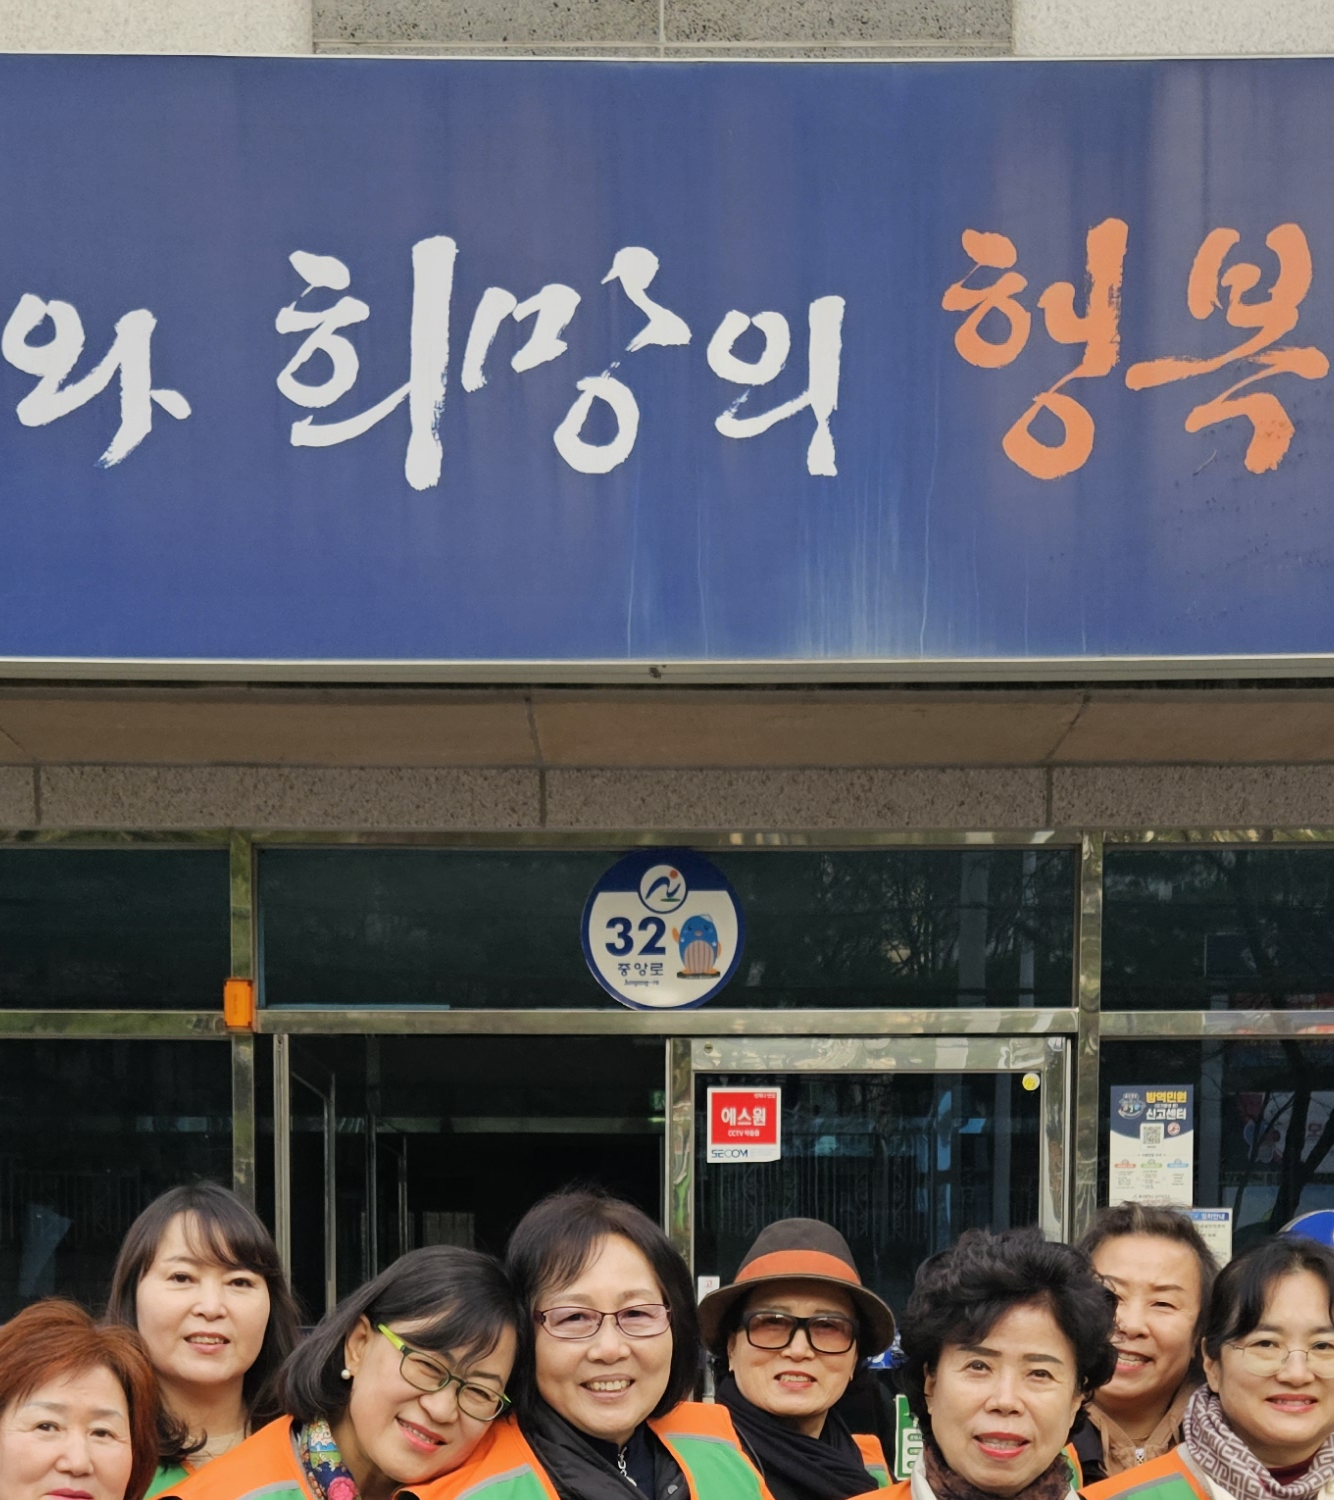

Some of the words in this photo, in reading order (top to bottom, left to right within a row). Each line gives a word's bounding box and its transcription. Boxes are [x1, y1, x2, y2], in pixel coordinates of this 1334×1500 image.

[275, 234, 845, 489] 희망의
[605, 916, 666, 957] 32
[618, 963, 663, 976] 중앙로
[721, 1107, 766, 1126] 에스원
[1146, 1108, 1187, 1120] 신고센터
[711, 1149, 748, 1158] SECOM
